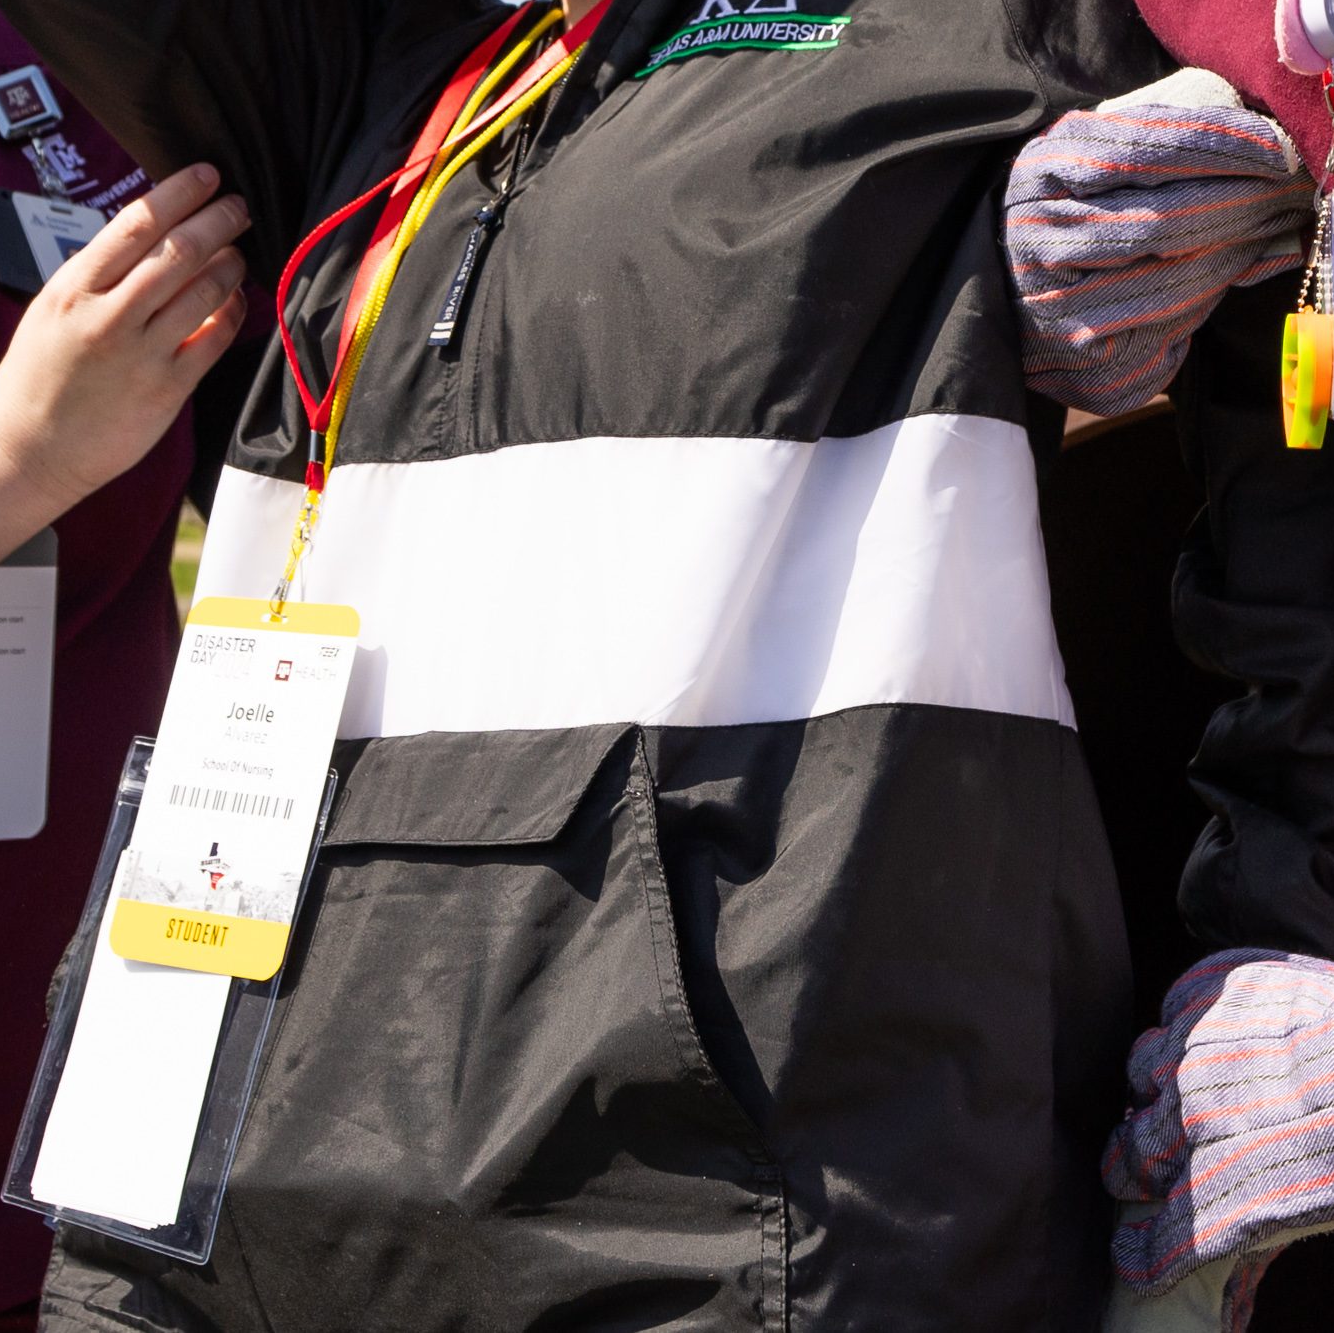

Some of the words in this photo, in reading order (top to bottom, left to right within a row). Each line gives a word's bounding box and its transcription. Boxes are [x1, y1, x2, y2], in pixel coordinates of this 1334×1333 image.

[690, 26, 730, 48] A&M
[730, 22, 845, 42] UNIVERSITY
[443, 285, 461, 321] RIVER
[194, 634, 256, 653] DISASTER
[190, 650, 217, 666] DAY
[226, 702, 275, 723] Joelle
[202, 756, 229, 771] School
[243, 761, 275, 780] Nursing
[166, 918, 229, 947] STUDENT
